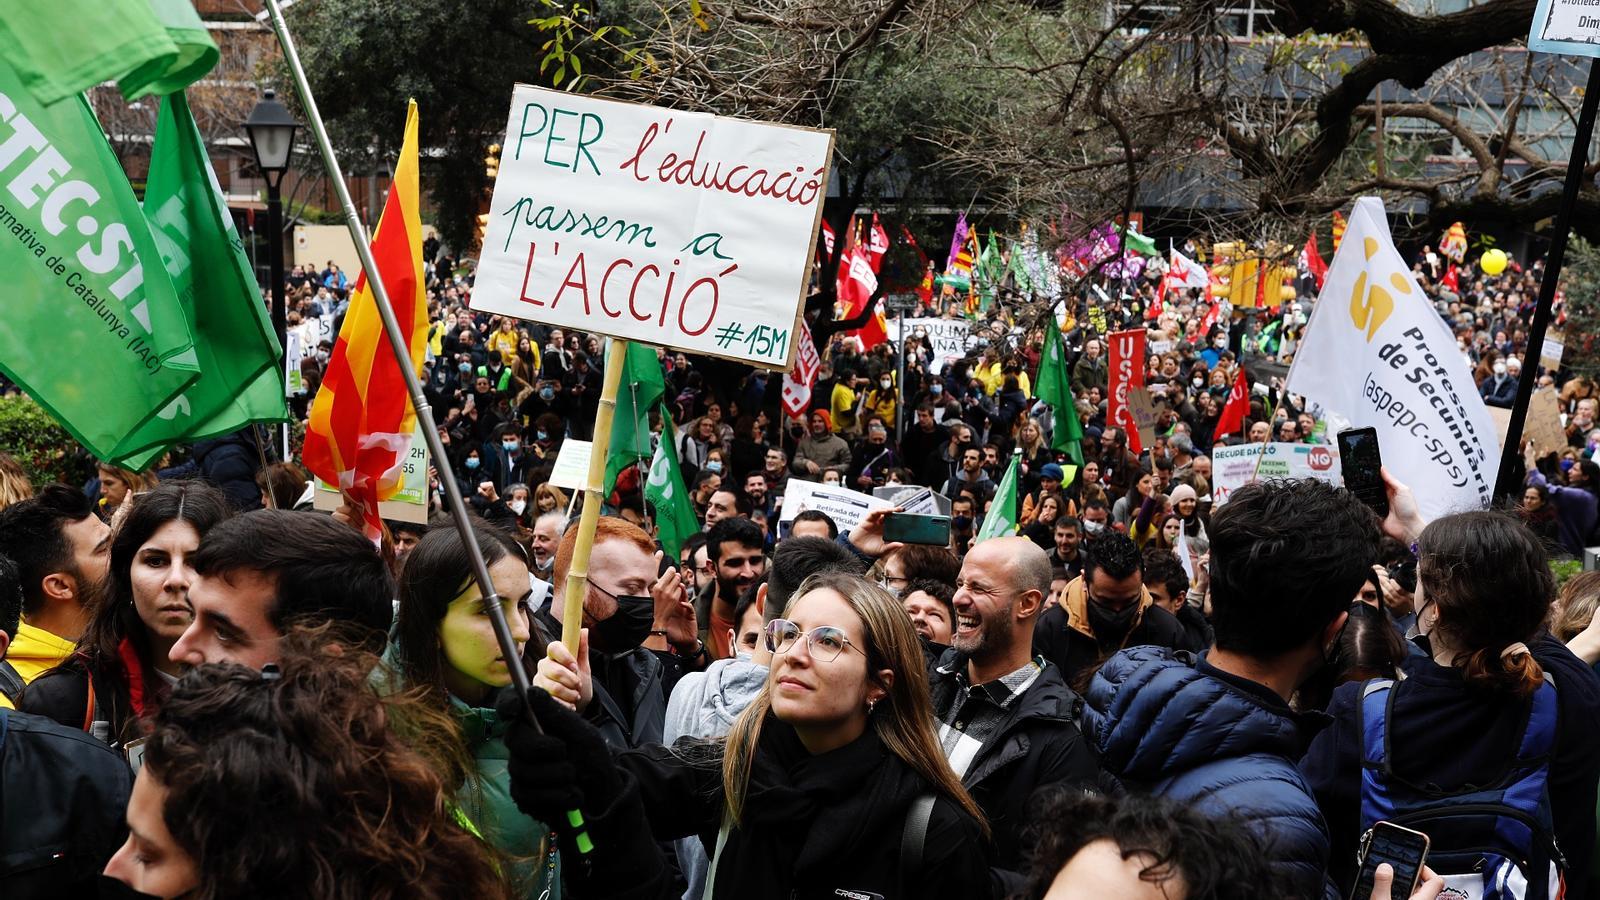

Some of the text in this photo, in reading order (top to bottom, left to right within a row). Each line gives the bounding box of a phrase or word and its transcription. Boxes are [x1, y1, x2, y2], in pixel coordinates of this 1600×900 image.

[515, 102, 825, 206] PER l'educació
[0, 92, 153, 335] TEC·ST
[503, 197, 734, 260] passem a
[45, 255, 66, 276] de
[65, 272, 130, 340] Catalunya
[127, 335, 163, 376] (IAC)
[715, 322, 787, 359] #15M
[1378, 343, 1491, 511] de Secundària
[1403, 326, 1486, 462] Professors
[1309, 453, 1330, 465] NO
[849, 510, 860, 518] del
